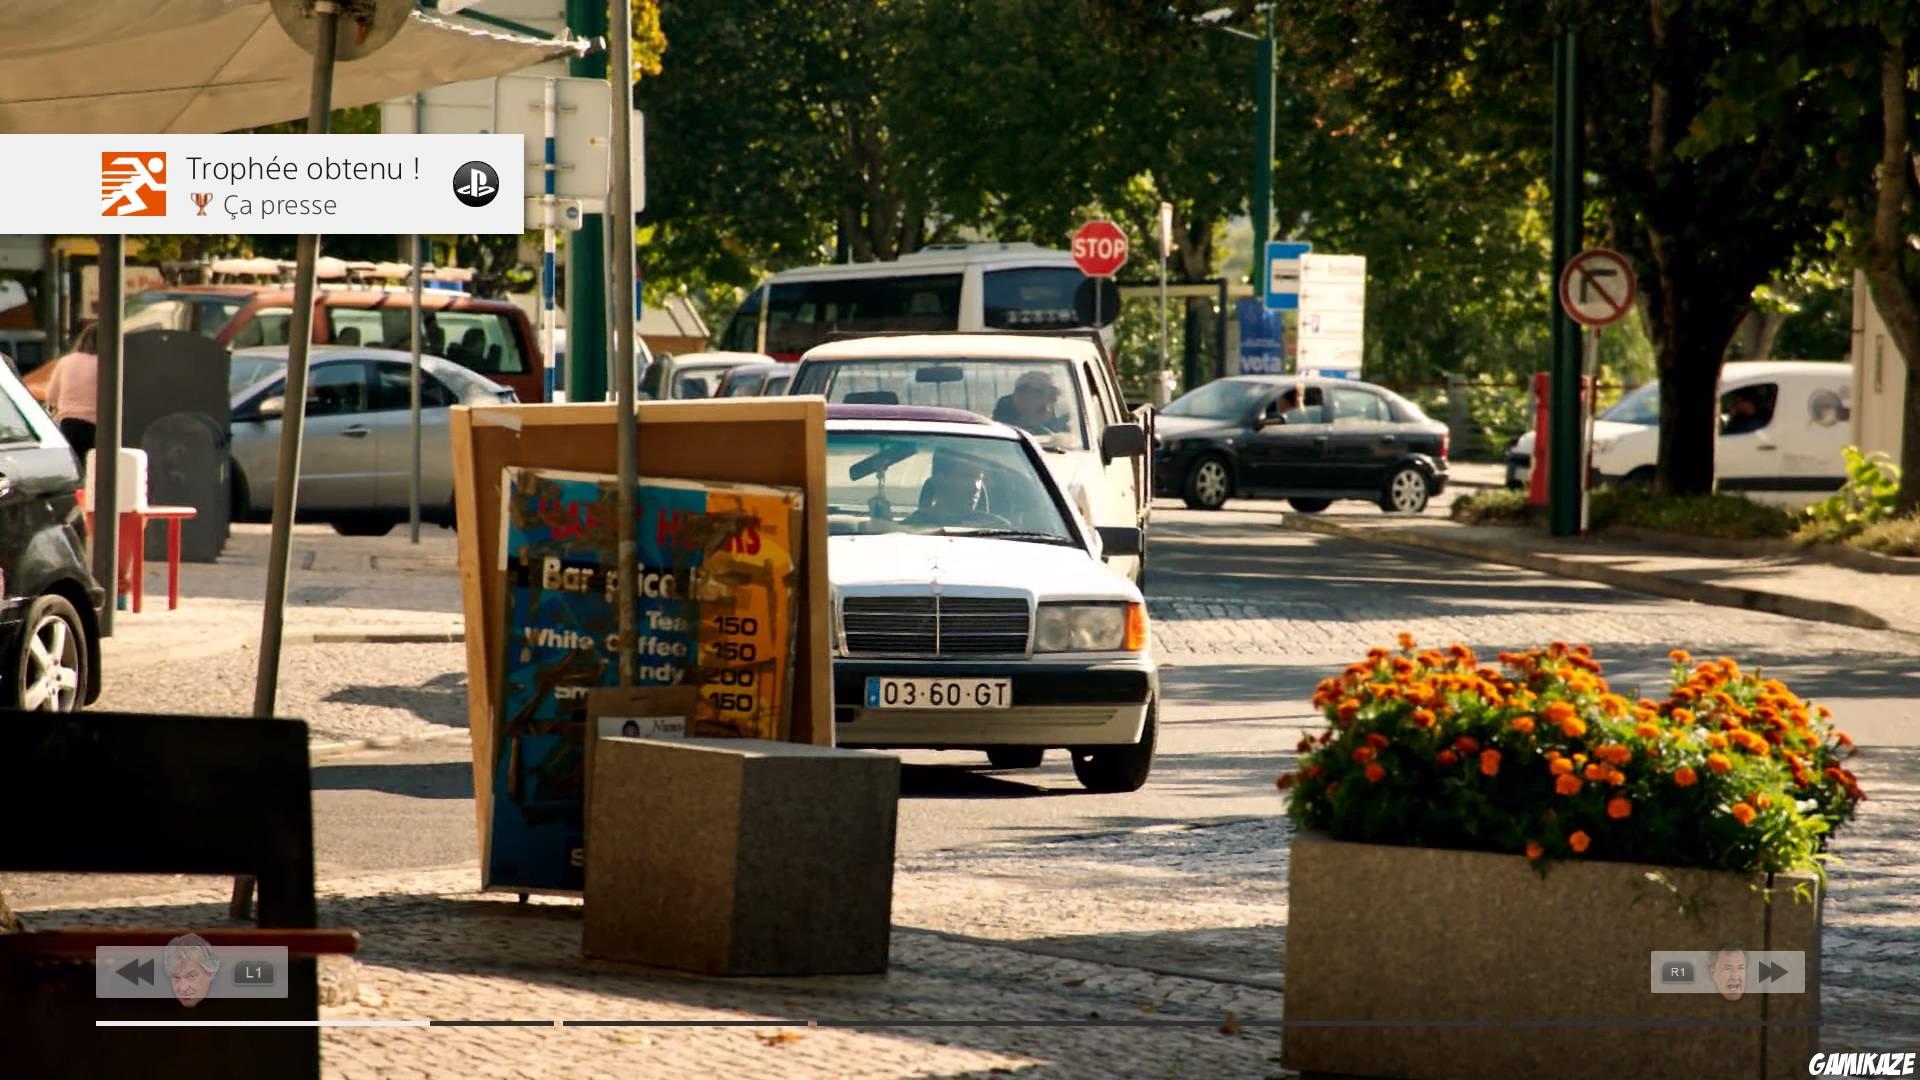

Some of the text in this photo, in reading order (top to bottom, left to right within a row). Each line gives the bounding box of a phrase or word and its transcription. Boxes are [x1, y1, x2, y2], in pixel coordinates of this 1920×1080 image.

[1074, 238, 1125, 259] STOP
[542, 556, 594, 592] Bar
[605, 562, 677, 604] pice
[645, 609, 758, 637] Tea 150
[523, 626, 757, 663] White Cffee 150
[709, 691, 753, 713] 150
